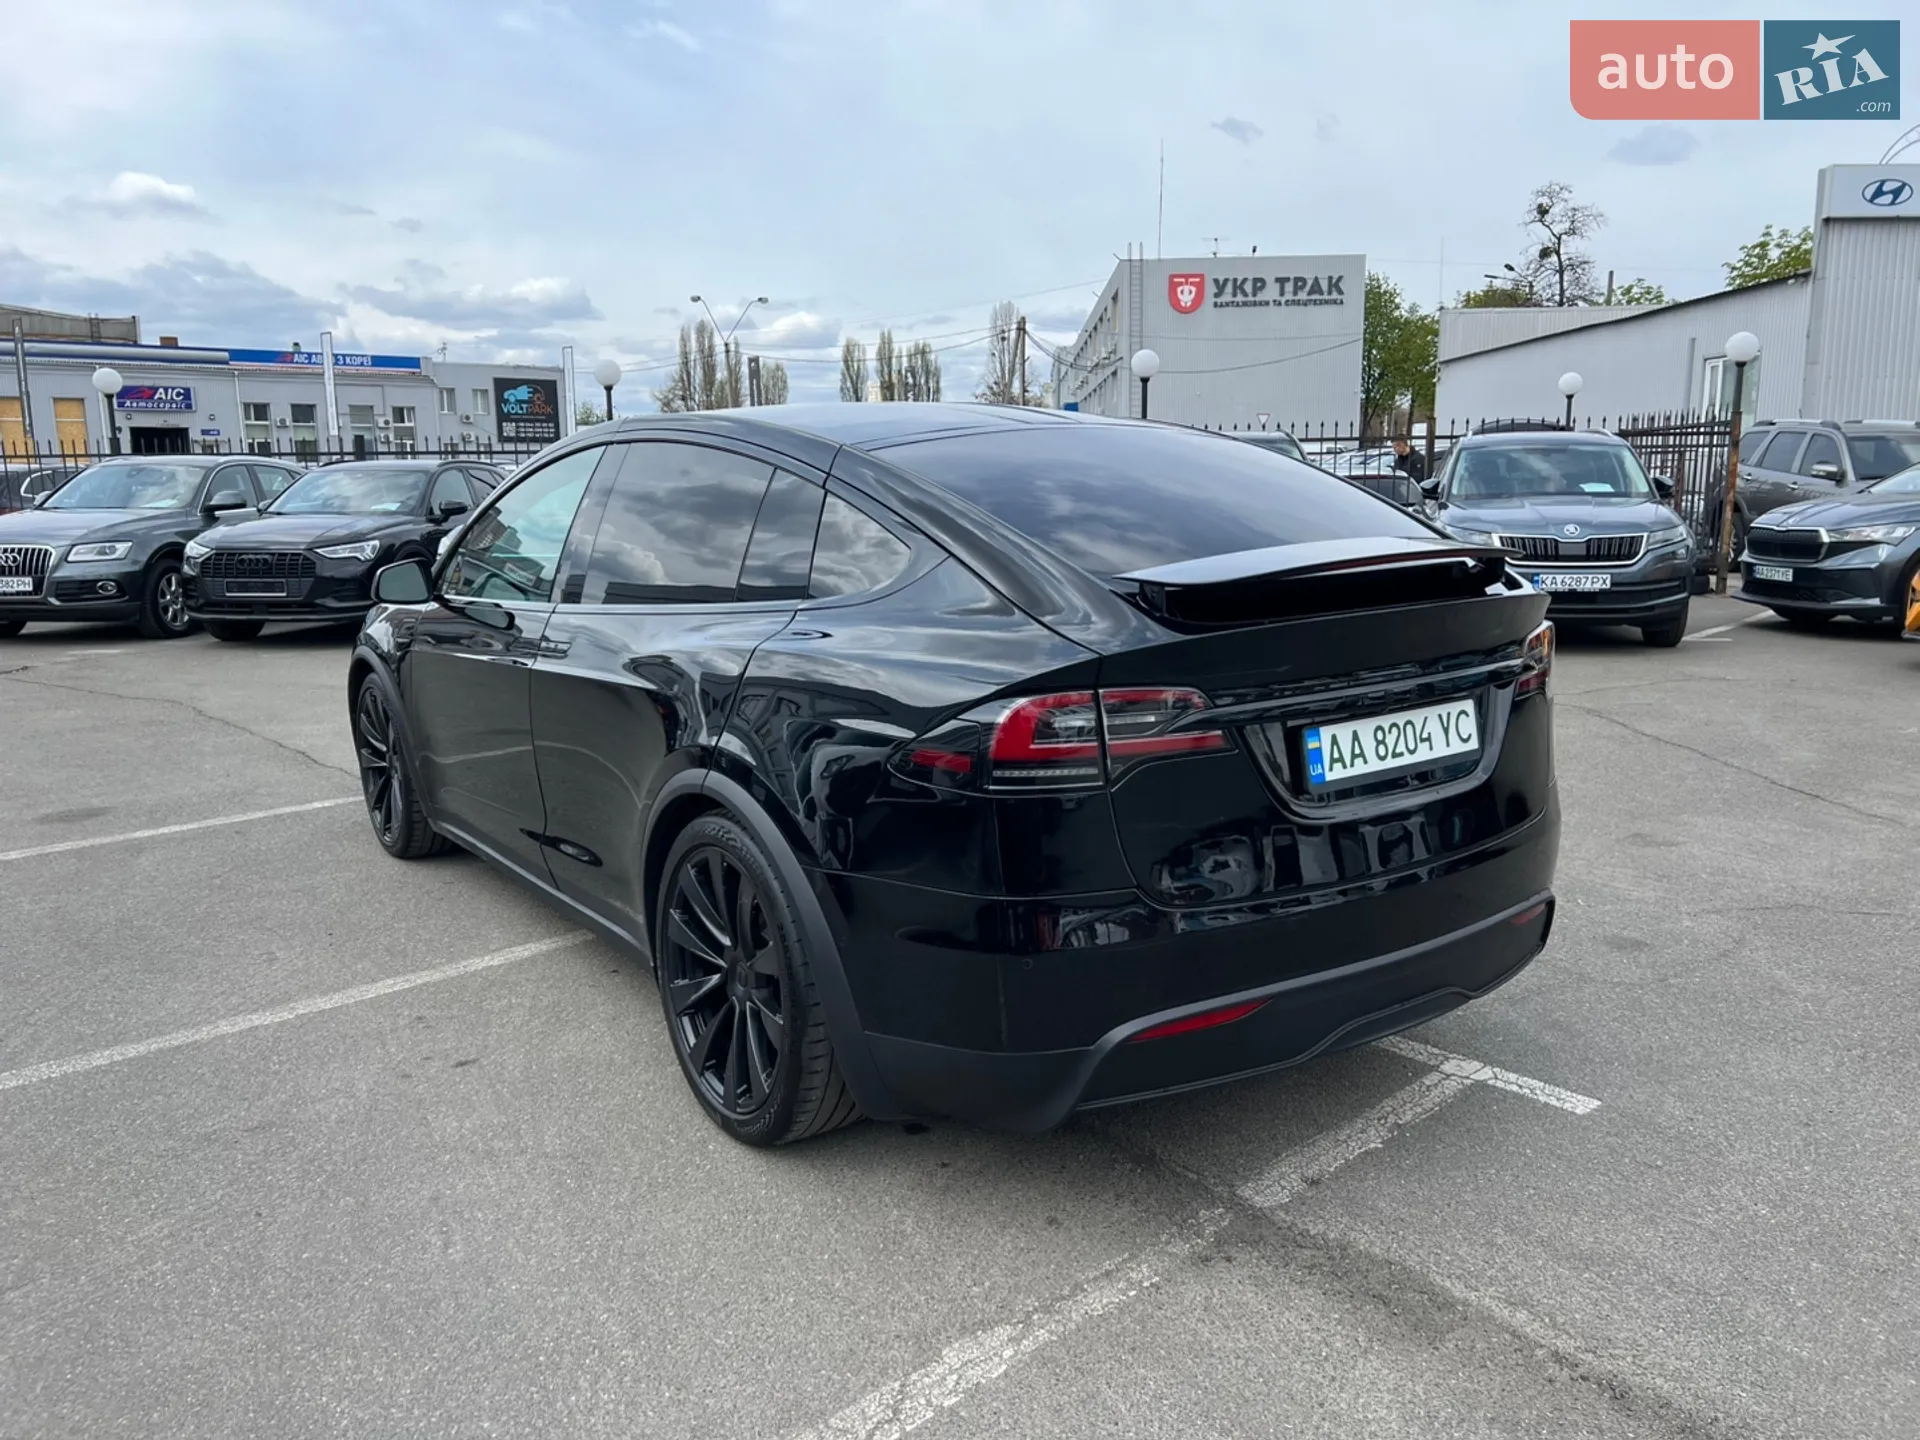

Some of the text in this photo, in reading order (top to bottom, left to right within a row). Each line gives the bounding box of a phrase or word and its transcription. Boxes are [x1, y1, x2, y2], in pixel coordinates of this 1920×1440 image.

[1212, 275, 1345, 298] УКР ТРАК
[1541, 576, 1609, 587] KA 6287 PX
[1328, 709, 1472, 773] AA 8204 YC
[1310, 763, 1324, 776] UA
